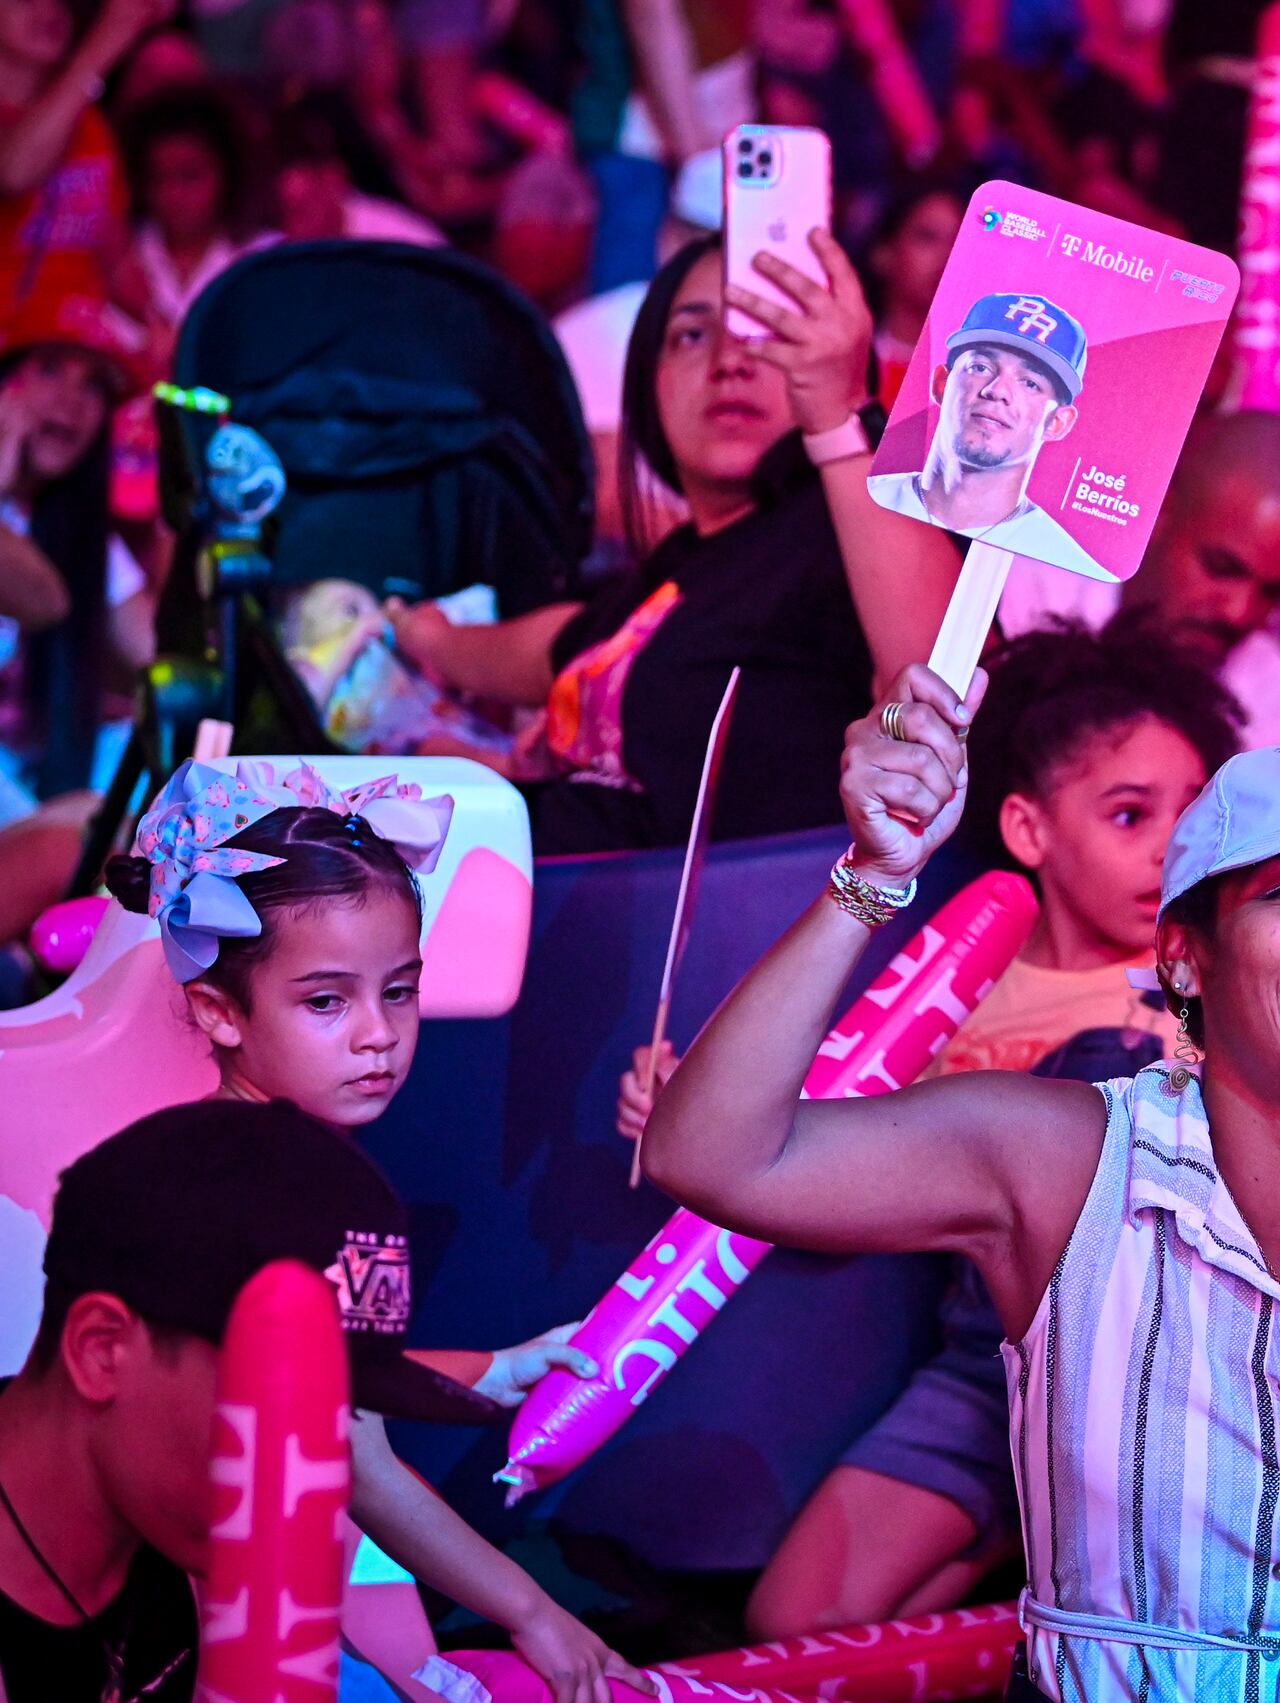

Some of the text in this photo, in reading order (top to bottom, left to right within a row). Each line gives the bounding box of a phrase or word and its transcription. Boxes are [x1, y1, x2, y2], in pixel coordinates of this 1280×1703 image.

[1003, 217, 1047, 238] BASEBALL
[1006, 211, 1038, 227] WORLD
[1001, 224, 1038, 242] CLASSIC
[1080, 241, 1154, 282] Mobile
[1081, 465, 1127, 491] José
[1075, 482, 1140, 517] Berríos
